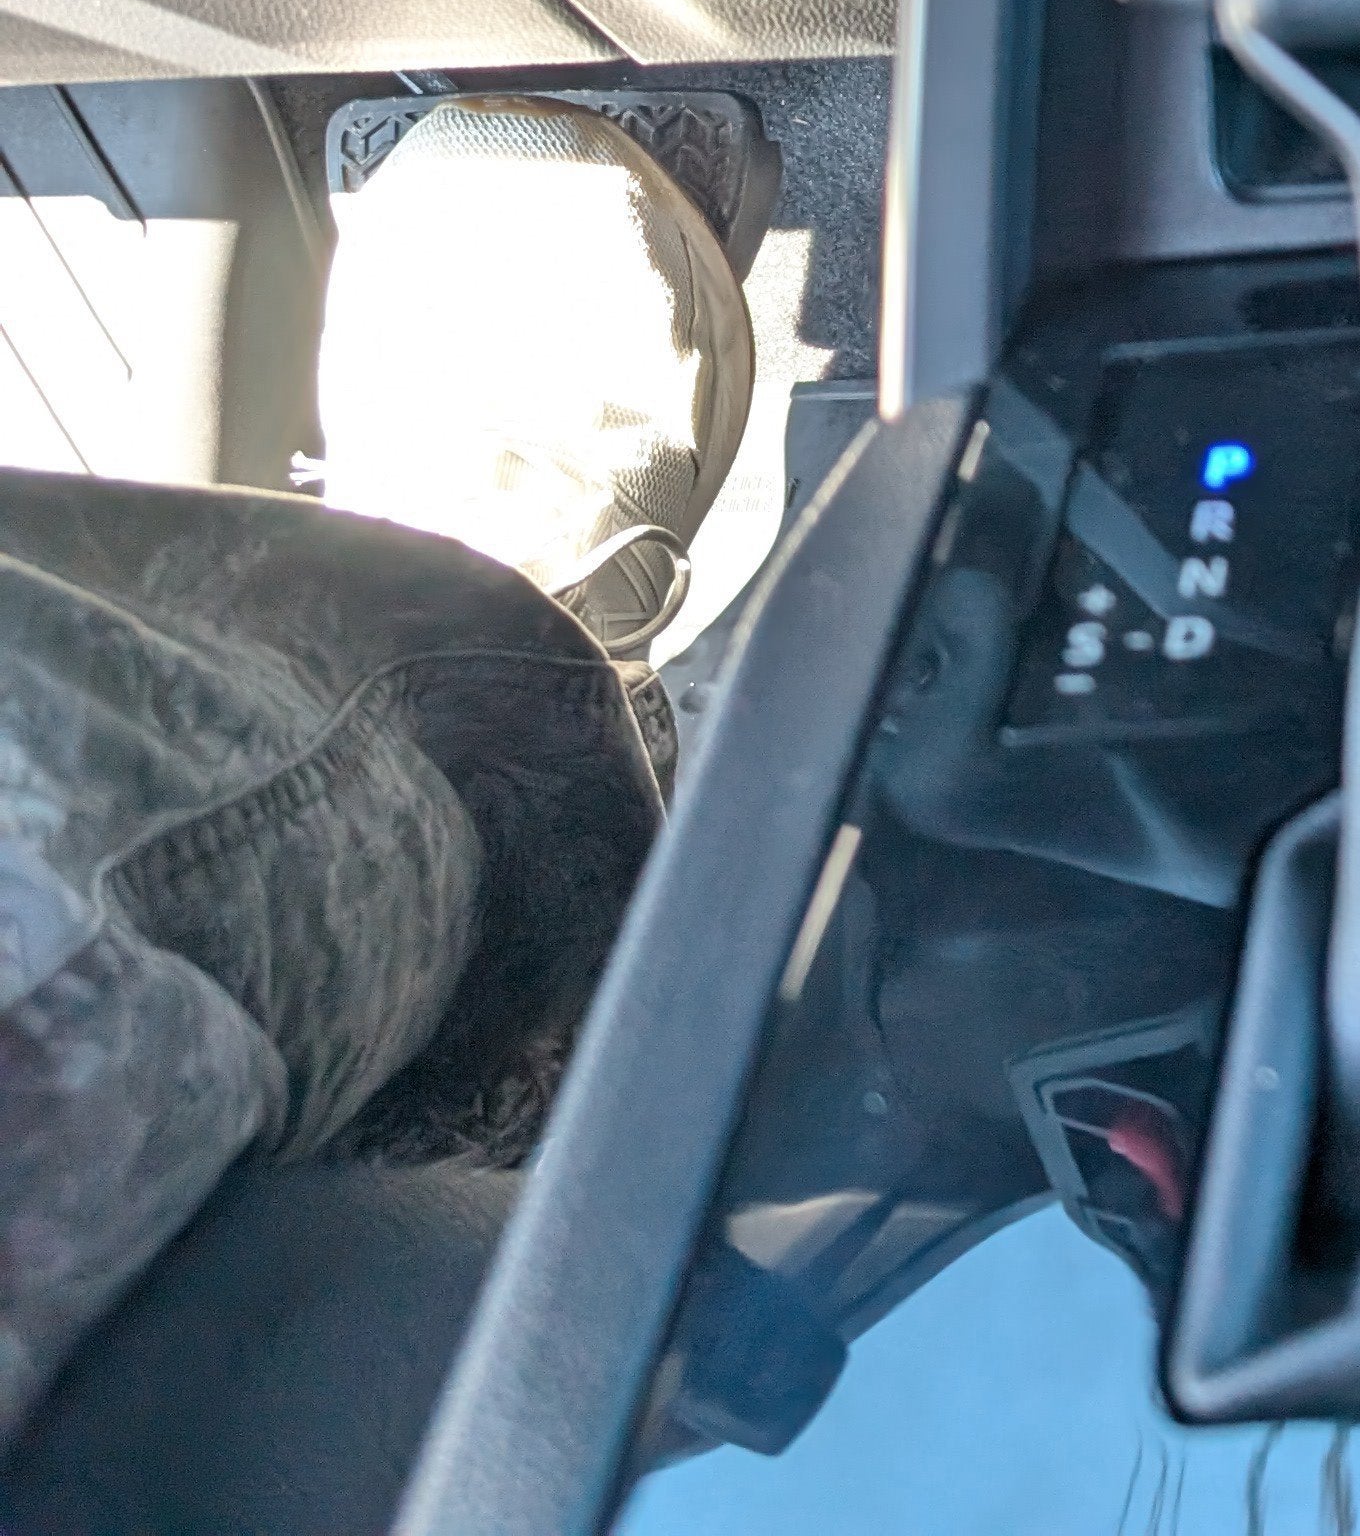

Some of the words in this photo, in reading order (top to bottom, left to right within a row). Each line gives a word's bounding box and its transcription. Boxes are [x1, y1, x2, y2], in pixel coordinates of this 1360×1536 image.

[1204, 442, 1253, 489] P
[1190, 499, 1236, 543] R
[1177, 556, 1228, 599] N
[1062, 620, 1107, 667] S
[1162, 615, 1214, 661] D
